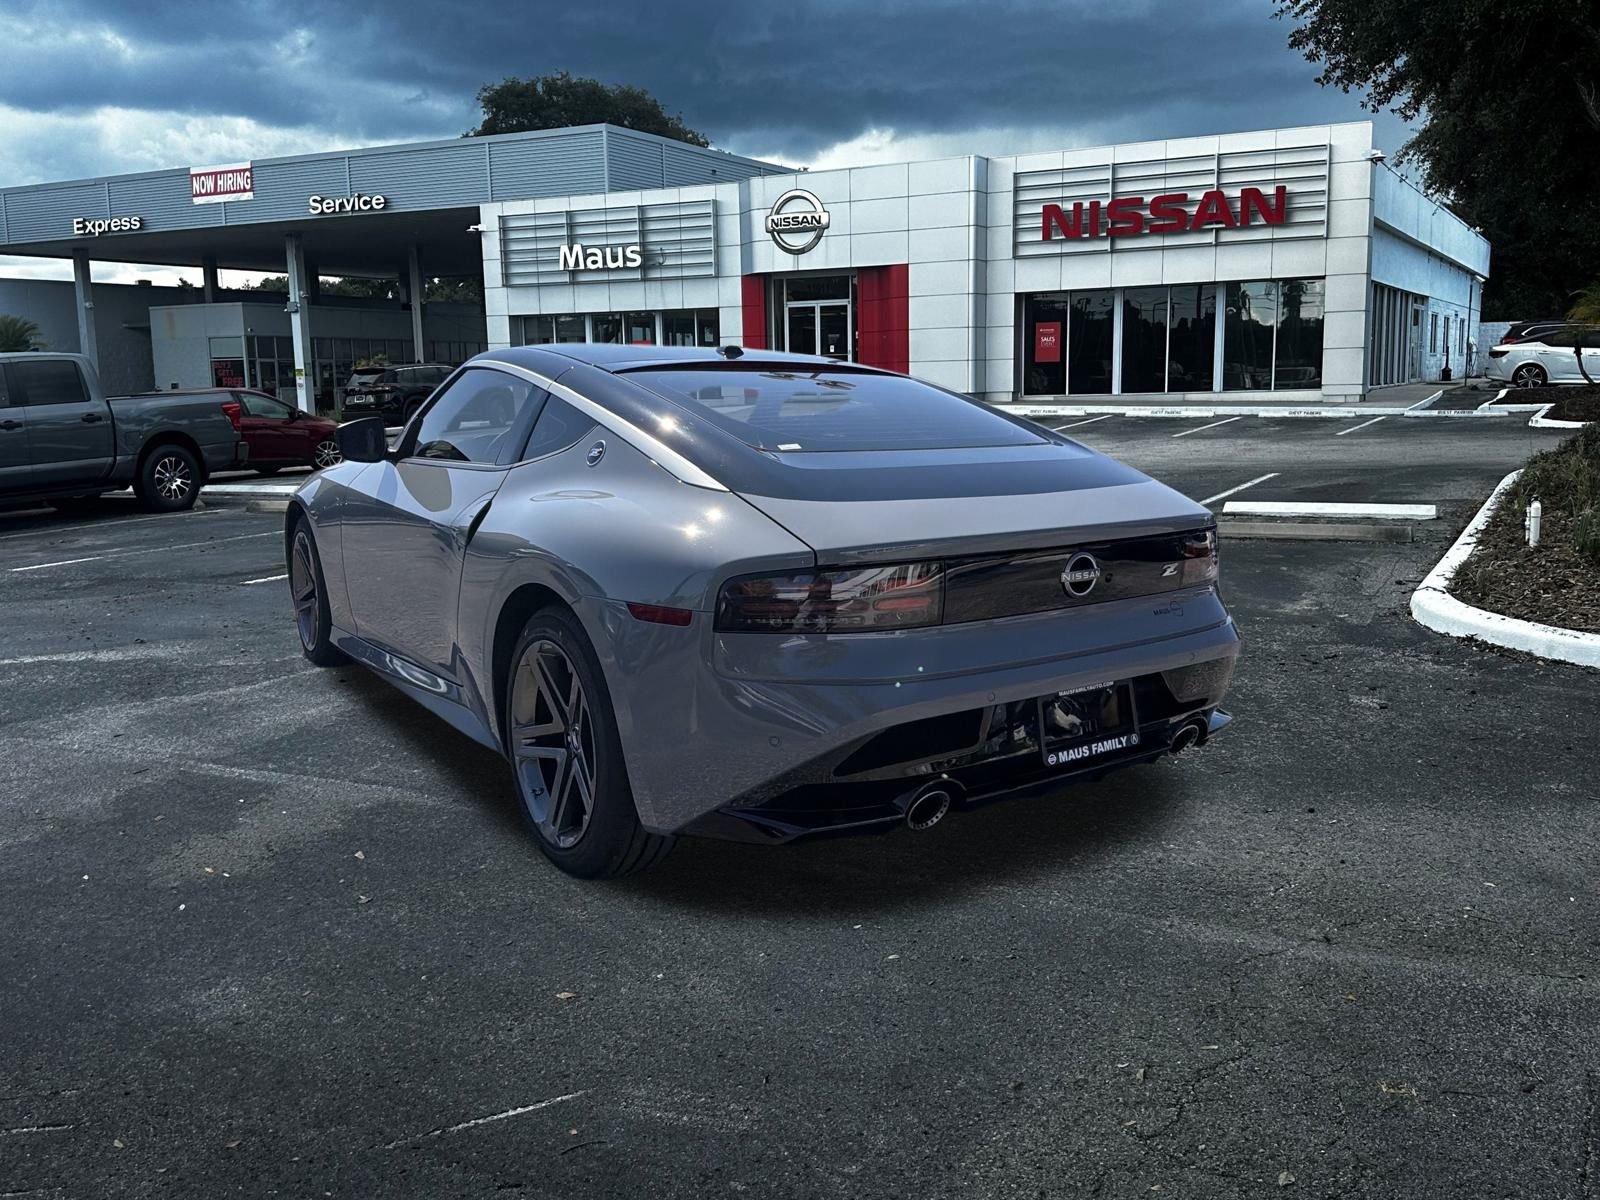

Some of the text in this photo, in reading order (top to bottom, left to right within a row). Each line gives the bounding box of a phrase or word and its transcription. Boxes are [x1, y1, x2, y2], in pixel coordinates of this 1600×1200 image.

[192, 171, 251, 195] NOW HIRING
[308, 193, 385, 214] Service
[1041, 185, 1287, 241] NISSAN
[73, 216, 141, 237] Express
[770, 215, 822, 229] NISSAN
[559, 243, 642, 271] Maus
[1062, 569, 1100, 581] NISSAN
[1161, 562, 1178, 577] Z
[1058, 735, 1128, 763] MAUS FAMILY
